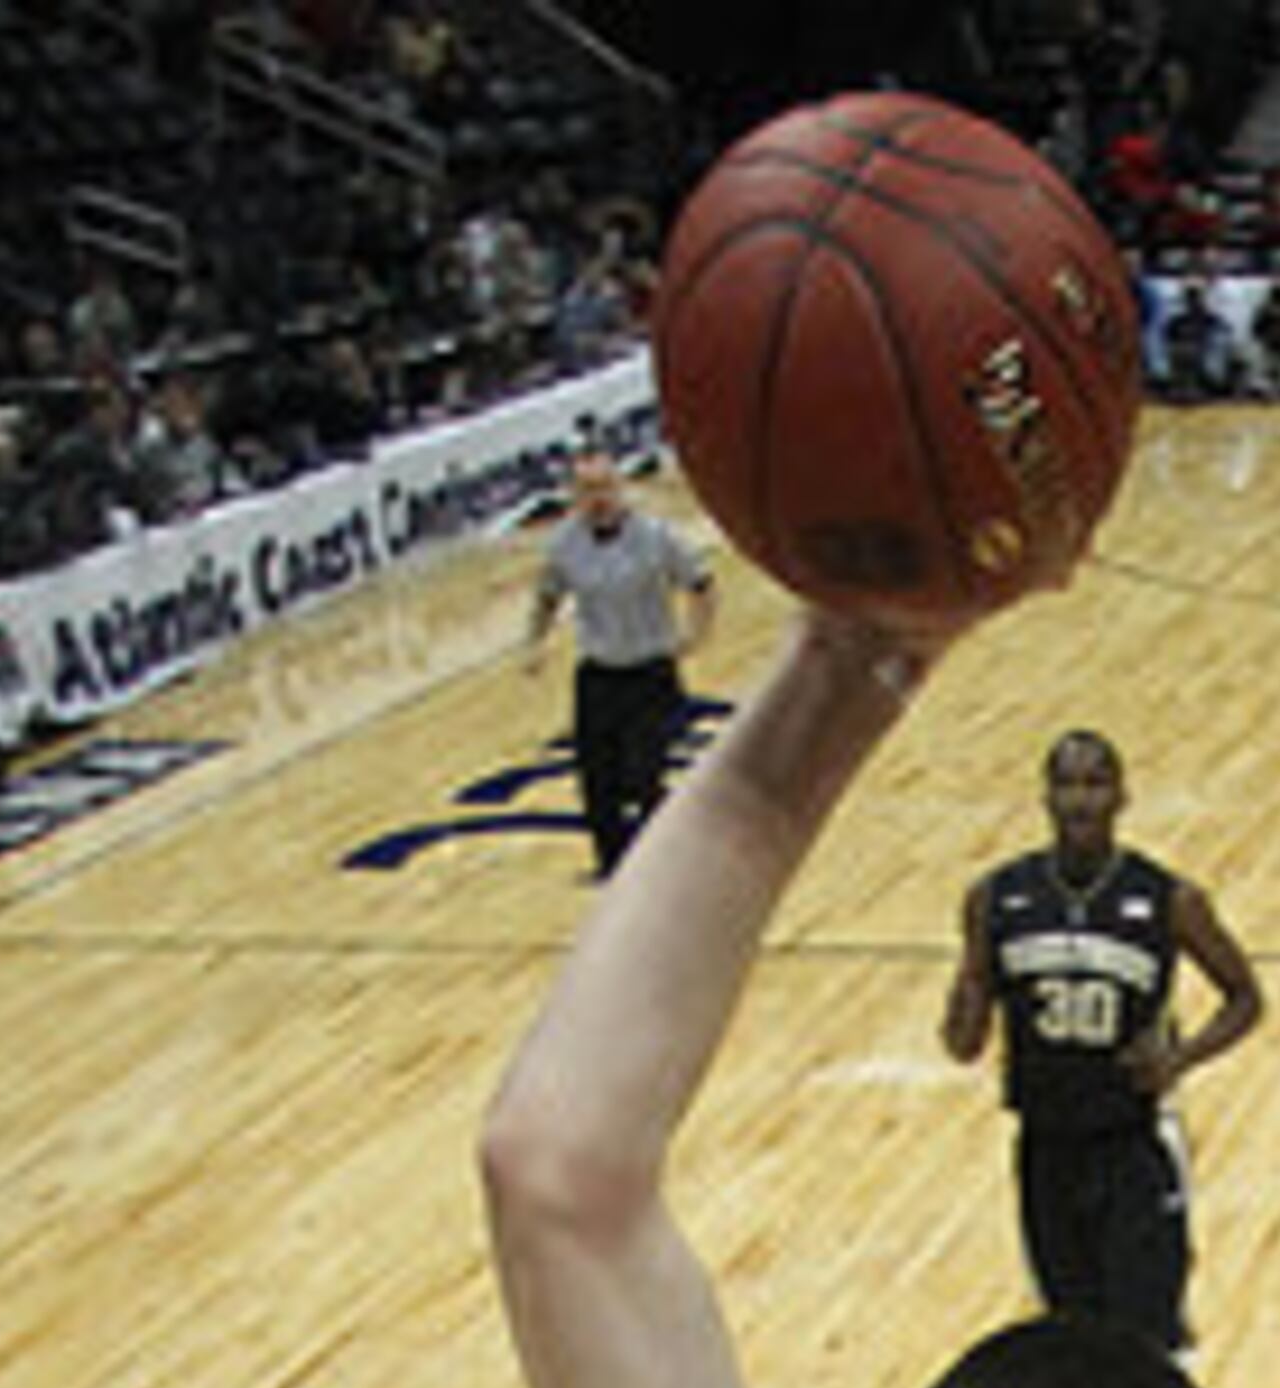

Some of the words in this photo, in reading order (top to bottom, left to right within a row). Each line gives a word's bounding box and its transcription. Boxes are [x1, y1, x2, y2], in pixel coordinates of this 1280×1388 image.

[51, 553, 246, 703] Atlantic
[250, 505, 376, 613] Coast
[1033, 977, 1121, 1048] 30
